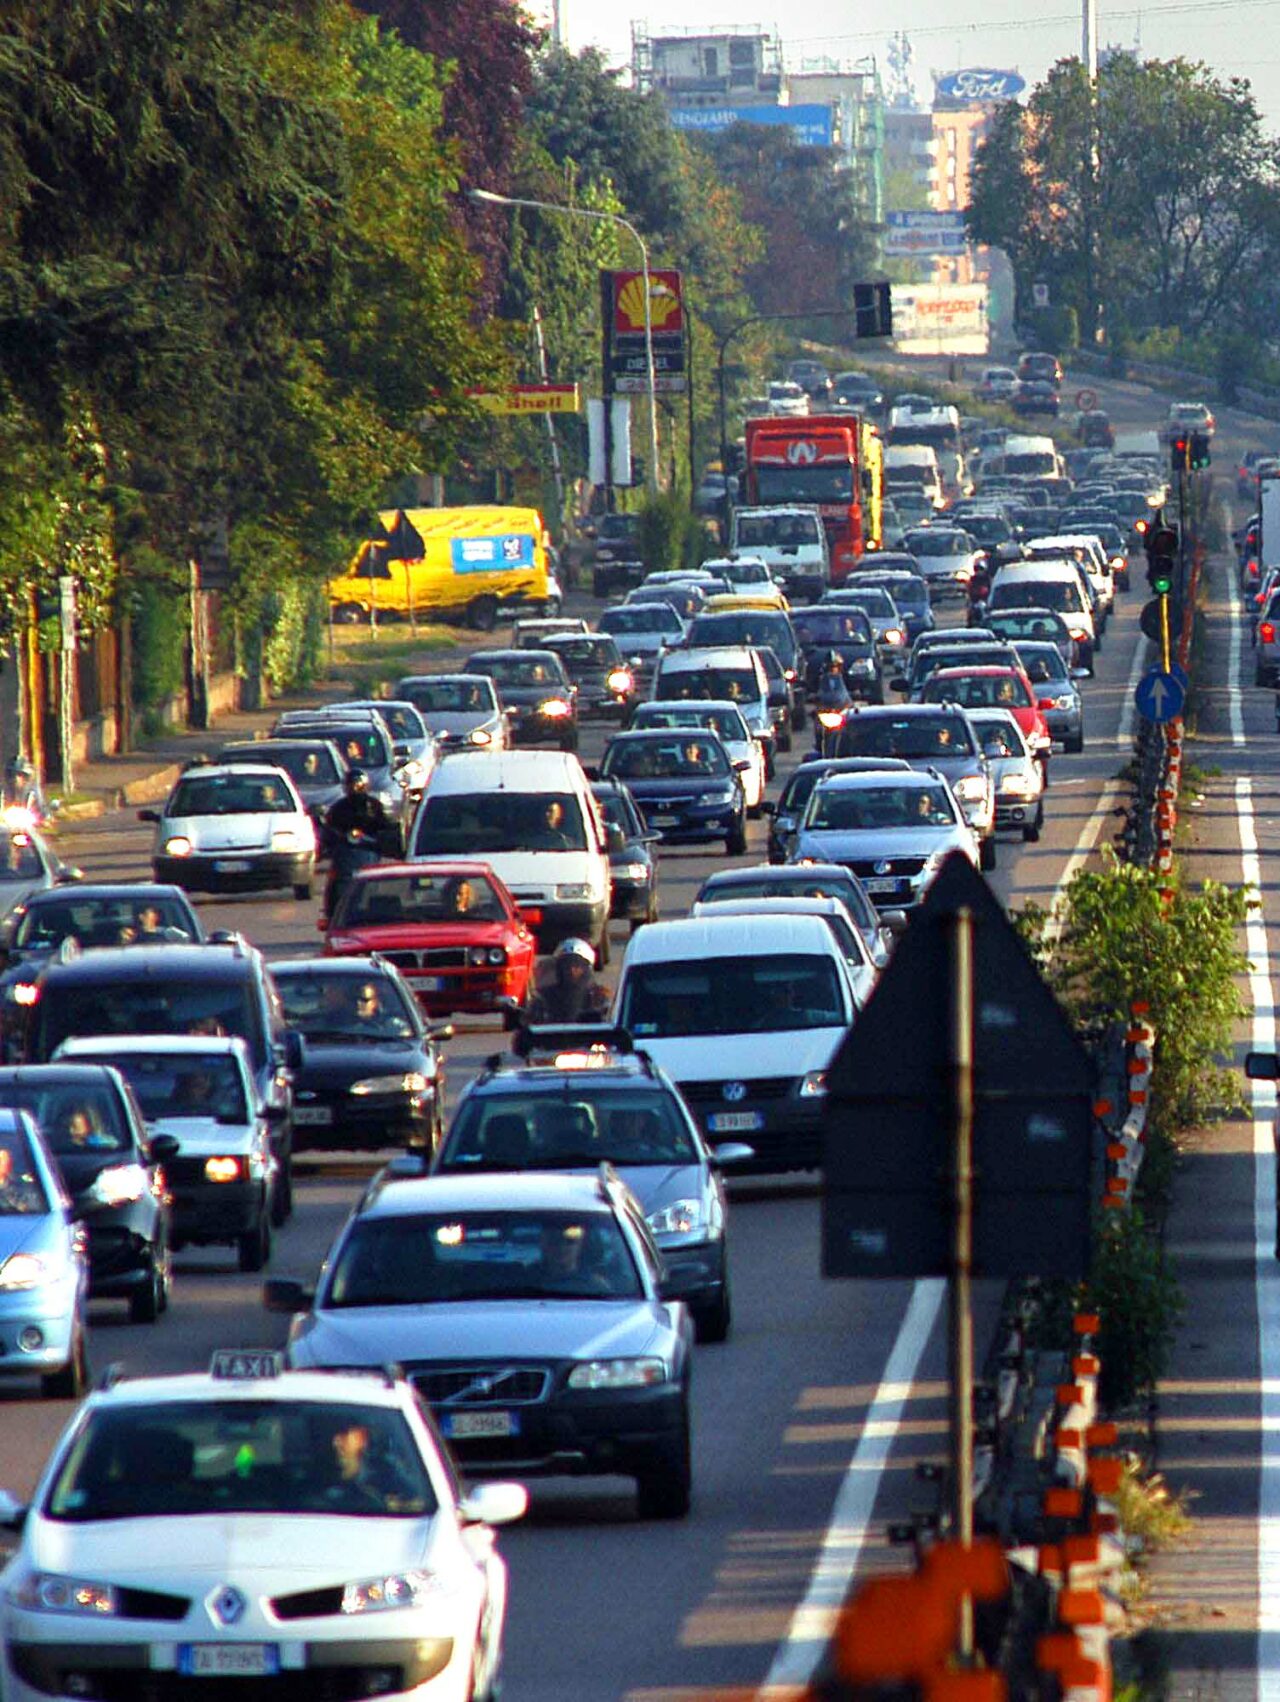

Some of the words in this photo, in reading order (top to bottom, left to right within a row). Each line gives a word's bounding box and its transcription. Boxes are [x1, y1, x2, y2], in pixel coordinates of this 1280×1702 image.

[952, 72, 1007, 97] Ford
[627, 357, 667, 370] DIEEL
[217, 1354, 273, 1378] TAXI
